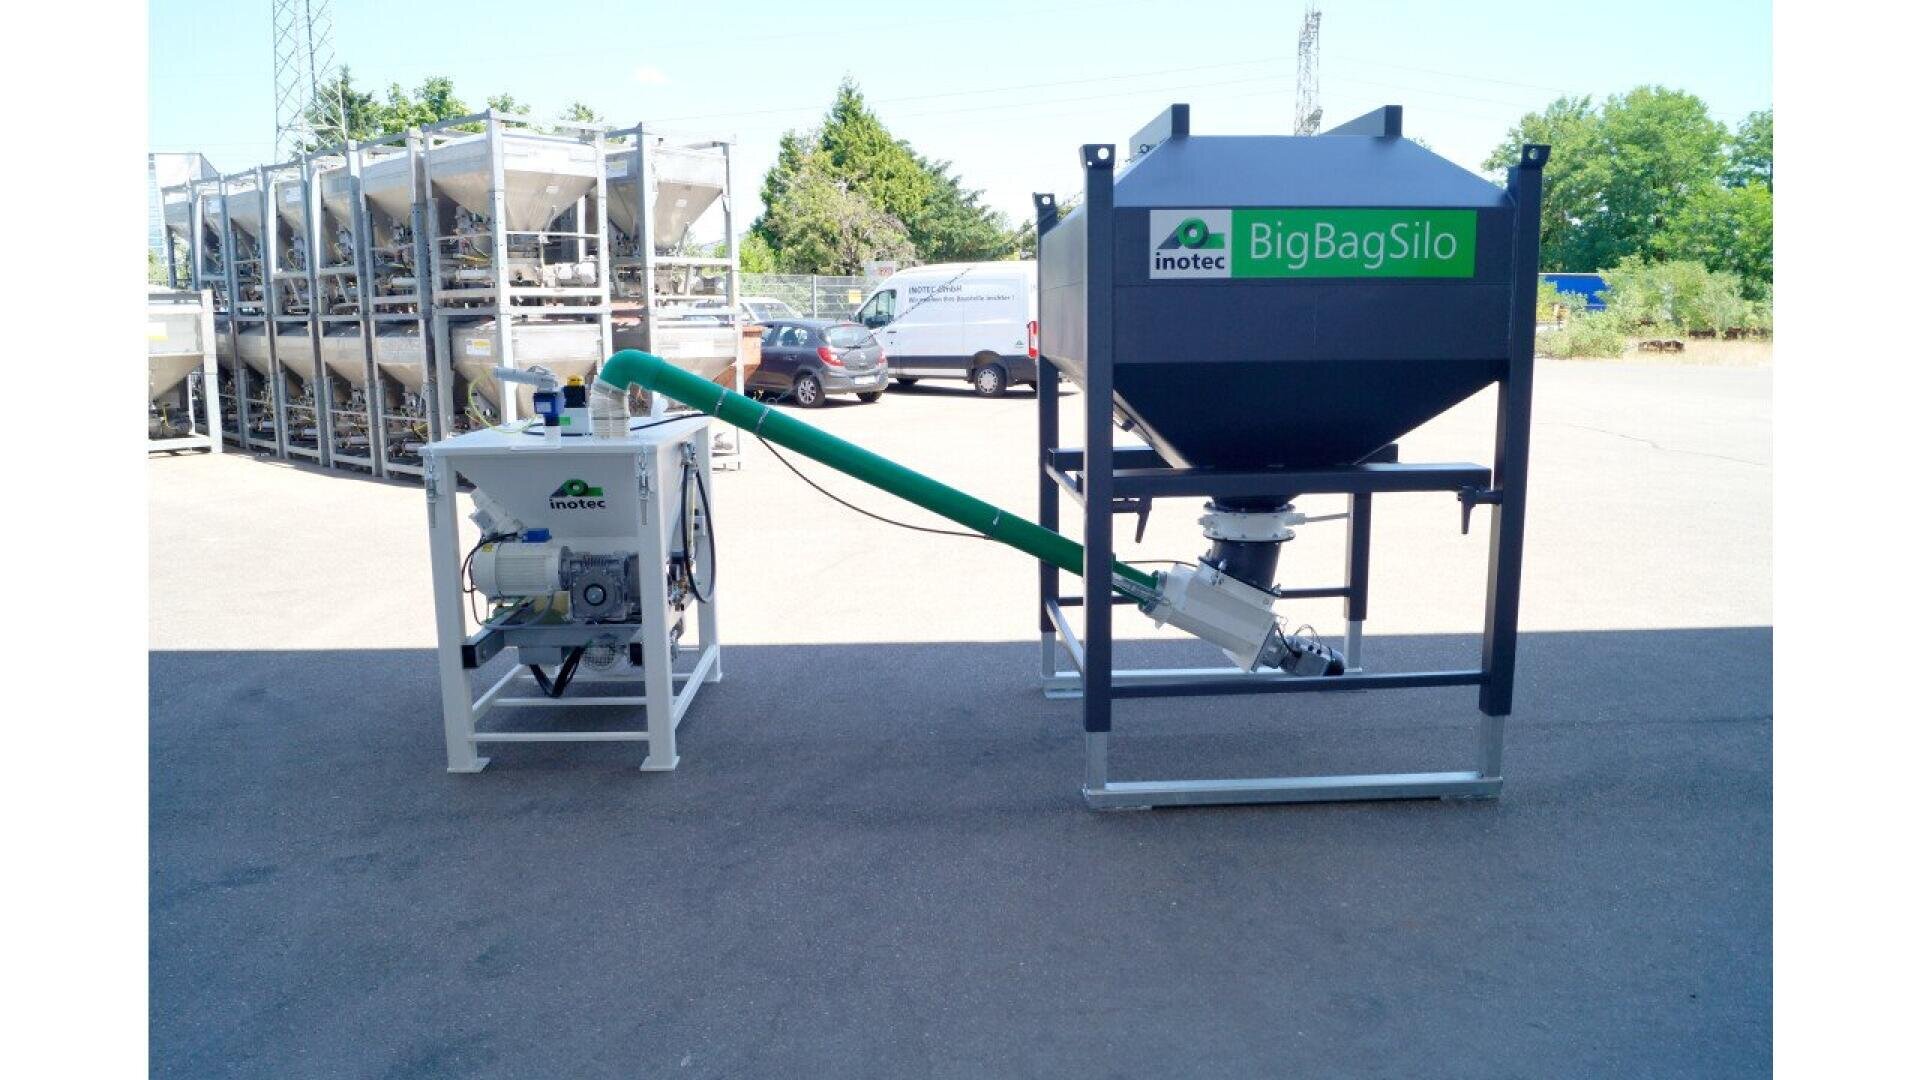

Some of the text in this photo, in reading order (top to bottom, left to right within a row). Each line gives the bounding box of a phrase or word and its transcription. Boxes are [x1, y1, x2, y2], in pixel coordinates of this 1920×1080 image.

[1155, 221, 1457, 270] inotec BigBagSilo
[908, 286, 935, 294] INOTEC
[550, 498, 606, 510] inotec
